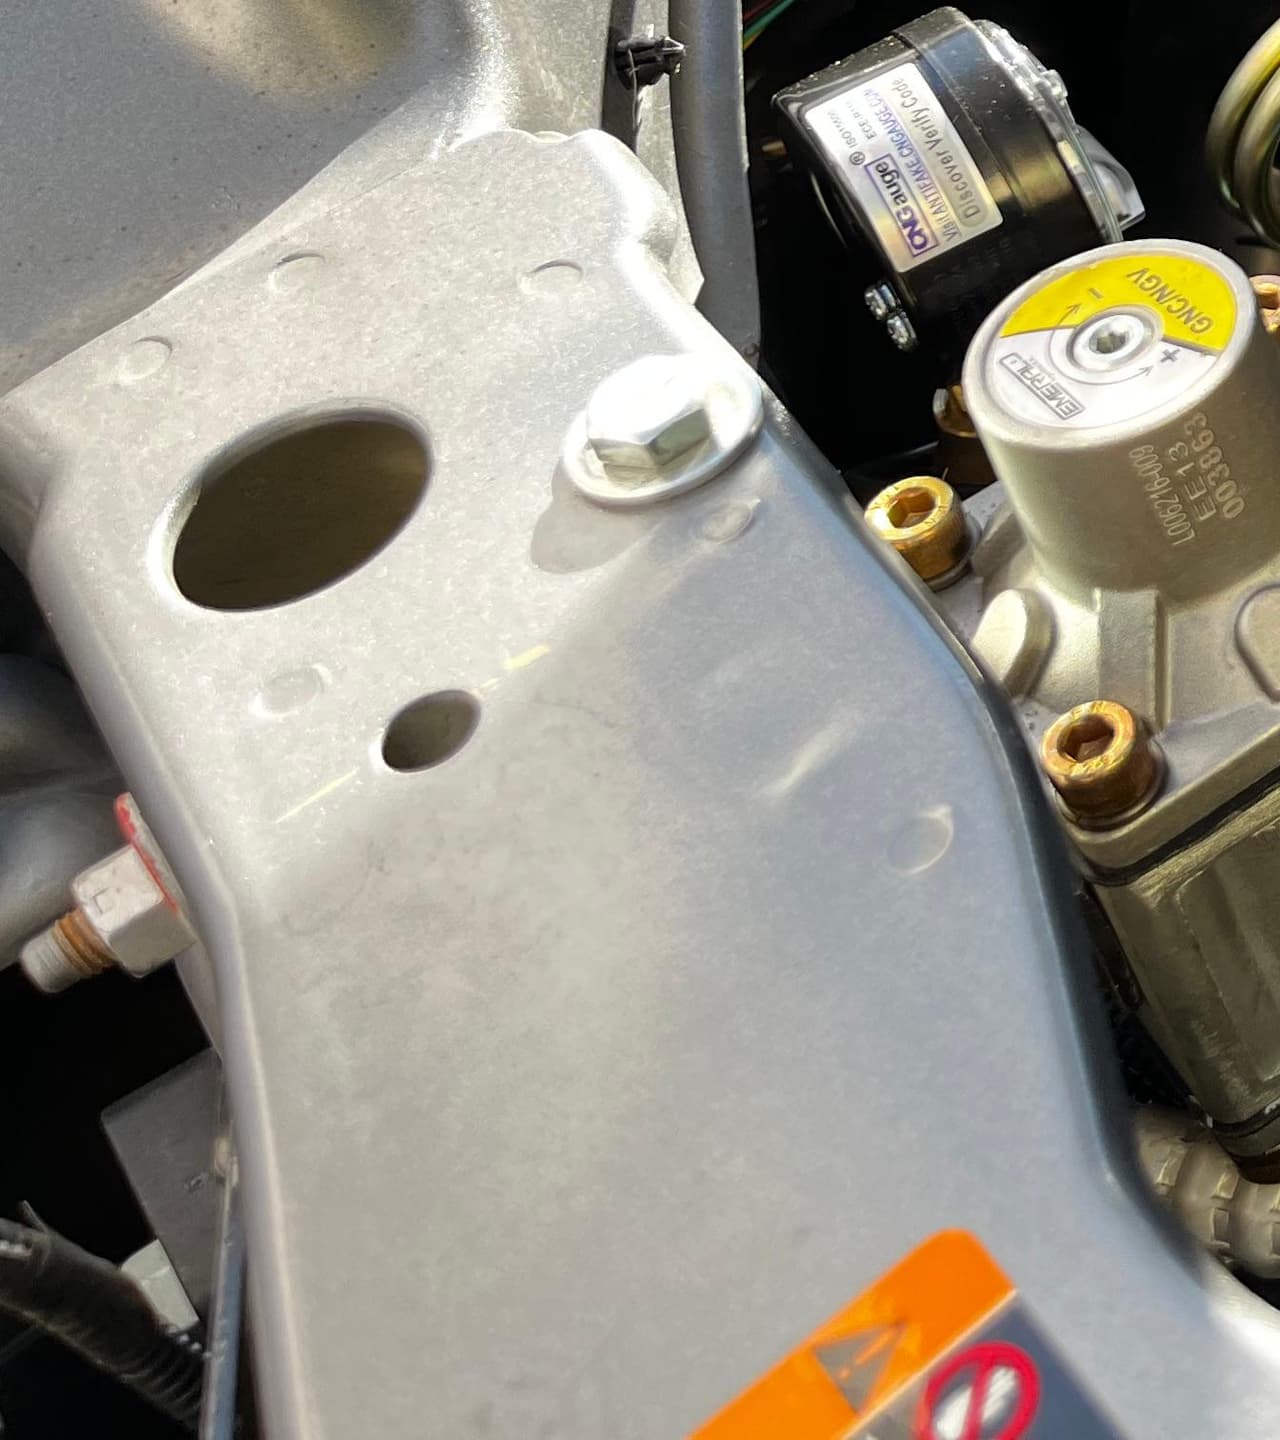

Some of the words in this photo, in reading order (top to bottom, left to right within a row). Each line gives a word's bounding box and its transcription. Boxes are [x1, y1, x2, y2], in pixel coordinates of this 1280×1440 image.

[892, 78, 919, 109] Code
[912, 107, 942, 151] Verify
[936, 150, 980, 220] Discover
[1126, 267, 1214, 334] GNC/NGV
[1129, 444, 1196, 546] L006216-009
[1184, 412, 1245, 518] 003863
